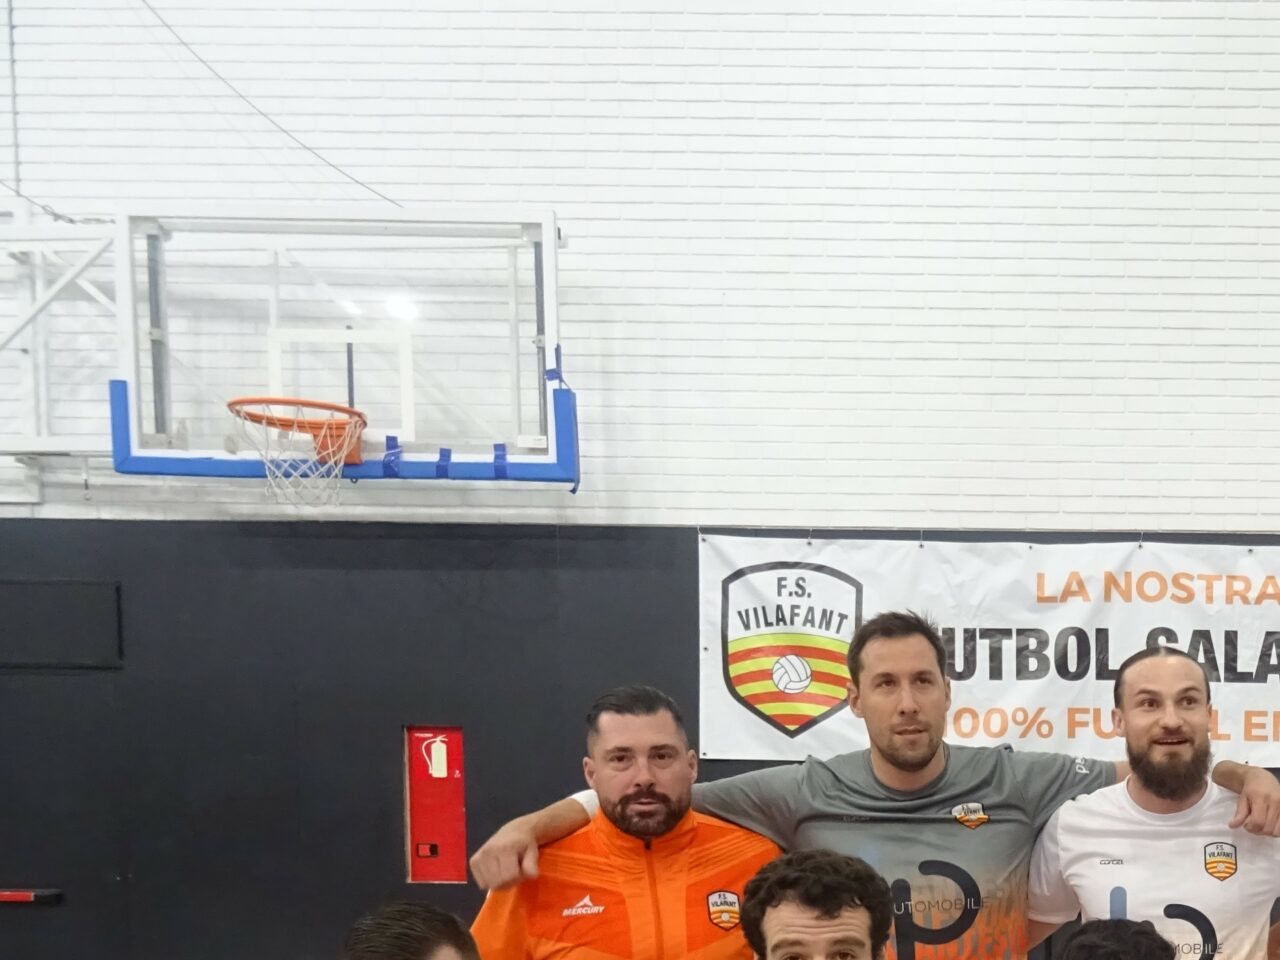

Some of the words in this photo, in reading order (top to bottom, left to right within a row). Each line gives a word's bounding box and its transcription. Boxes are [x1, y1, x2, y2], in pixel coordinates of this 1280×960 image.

[777, 576, 812, 598] F.S.
[1035, 571, 1092, 604] LA
[736, 603, 849, 635] VILAFANT
[939, 626, 1119, 682] UTBOL
[943, 706, 1054, 741] 00%
[1066, 707, 1231, 742] FUL
[1207, 851, 1233, 859] VILAFANT
[562, 905, 606, 918] MERCURY
[893, 896, 991, 916] UTOMOBILE
